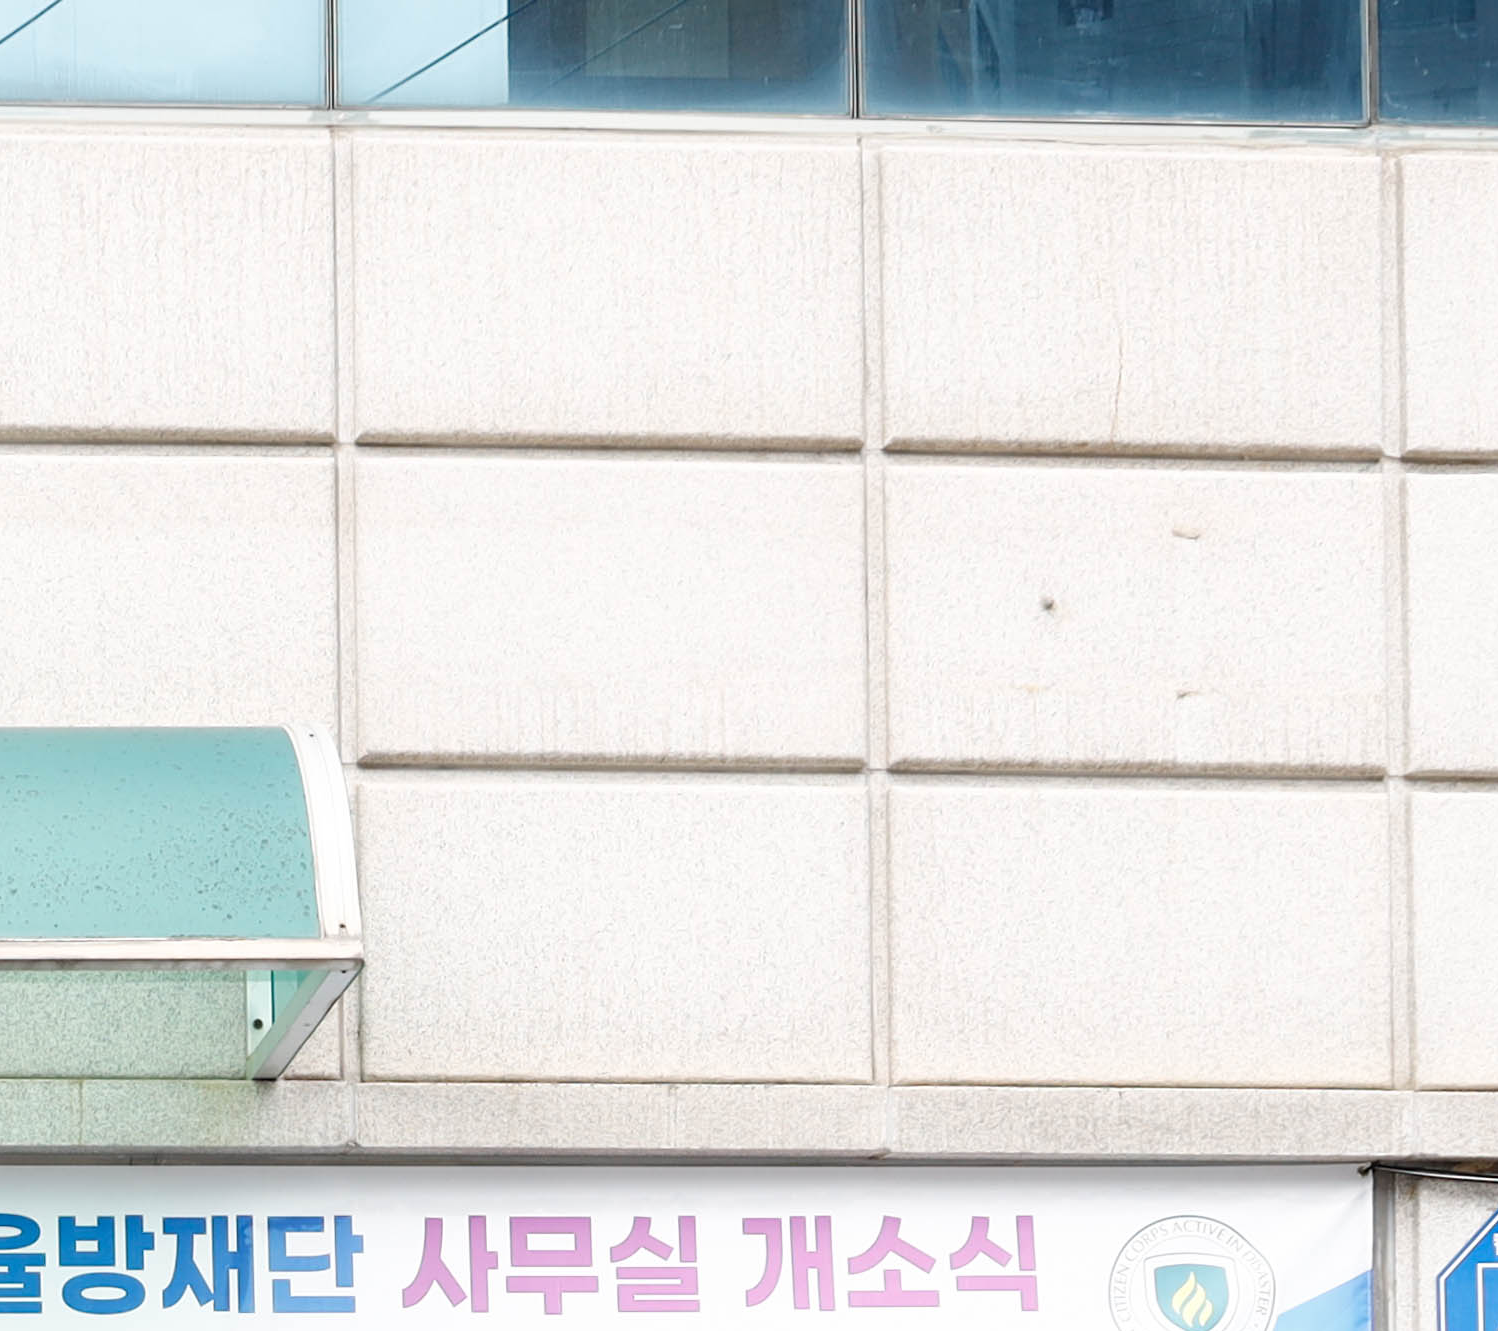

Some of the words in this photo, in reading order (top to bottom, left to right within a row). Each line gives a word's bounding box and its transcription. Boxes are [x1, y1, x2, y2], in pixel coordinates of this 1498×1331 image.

[403, 1215, 701, 1316] 사무실
[742, 1214, 1042, 1313] 개소식
[1113, 1263, 1131, 1324] CITIZEN
[1124, 1222, 1170, 1263] CORPS
[1172, 1220, 1227, 1242] ACTIVE
[1225, 1234, 1245, 1254] IN
[1241, 1249, 1272, 1317] DISASTER
